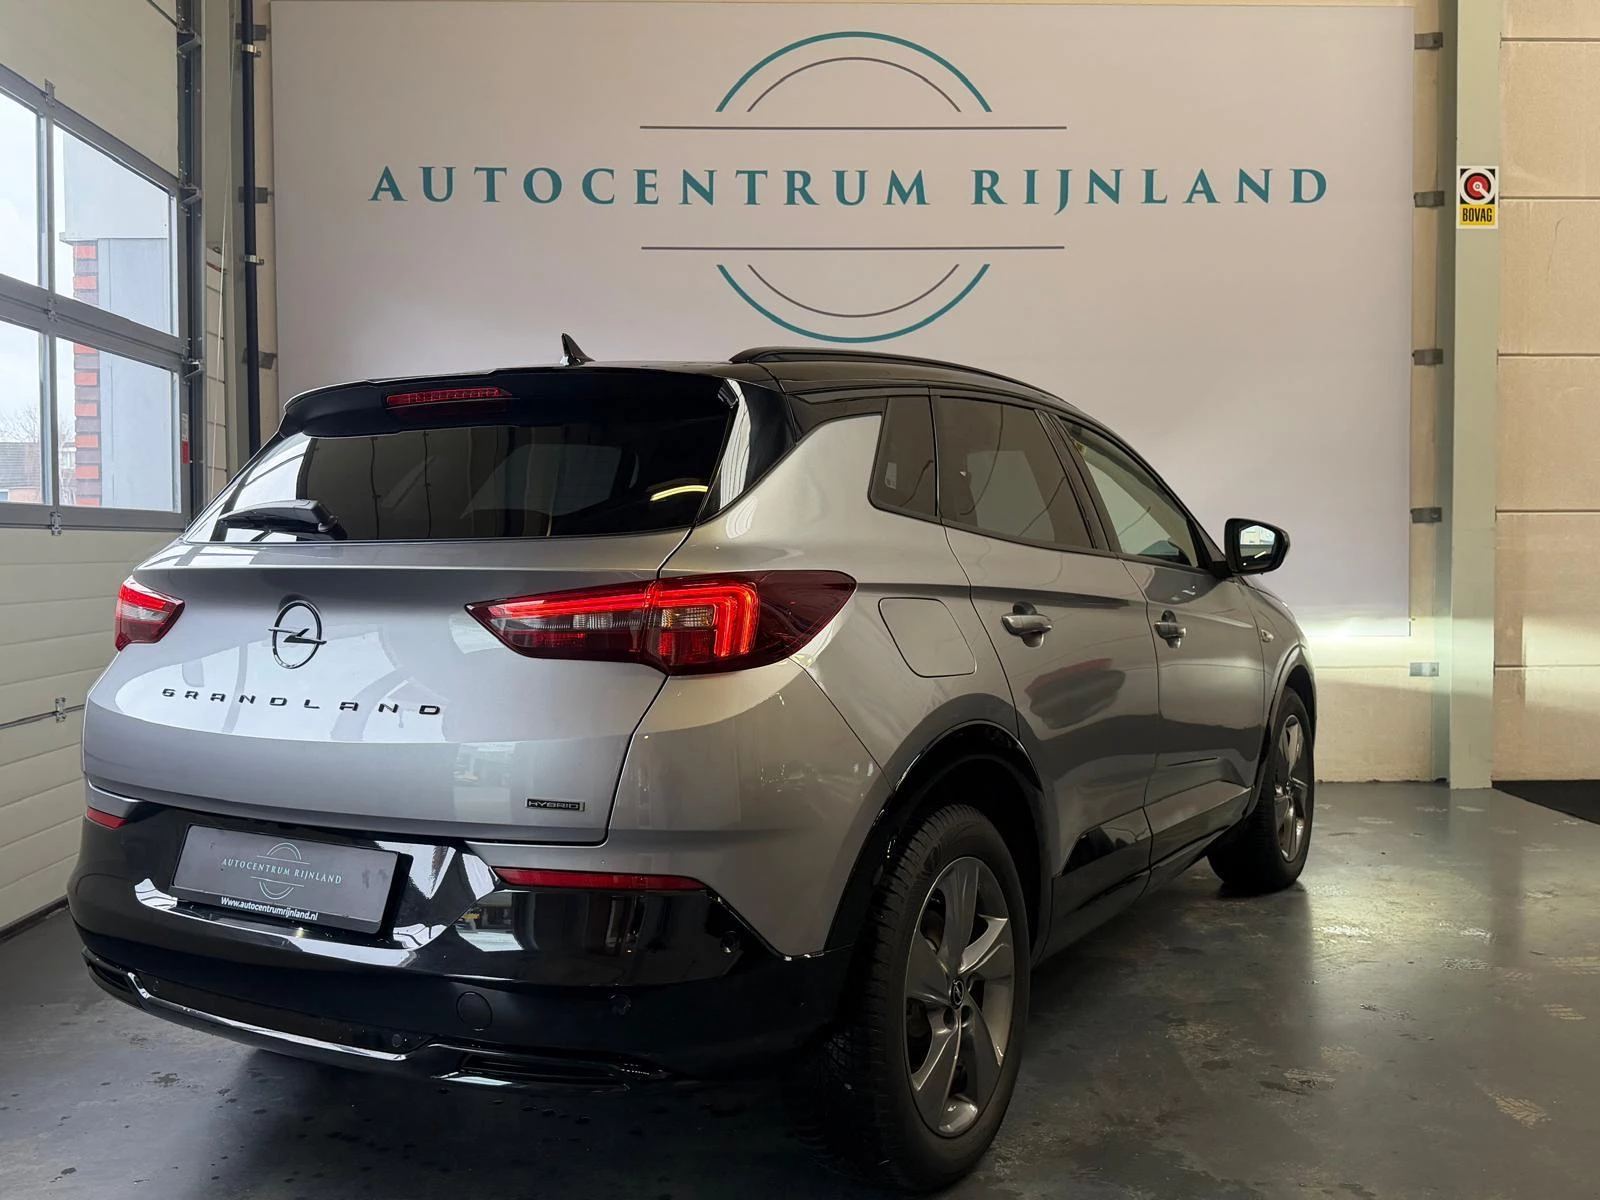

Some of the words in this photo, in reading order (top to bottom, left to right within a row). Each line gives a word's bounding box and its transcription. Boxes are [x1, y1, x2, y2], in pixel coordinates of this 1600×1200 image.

[371, 164, 930, 206] AUTOCENTRUM
[971, 166, 1329, 215] RIJNLAND
[1462, 207, 1493, 223] BOVAG
[162, 687, 442, 716] GRANDLAND
[528, 800, 579, 809] HYBRID
[221, 857, 291, 877] AUTOCENTRUM
[294, 867, 342, 885] RIJNLAND
[220, 896, 319, 922] Www.autocentrumrijnland.nl
